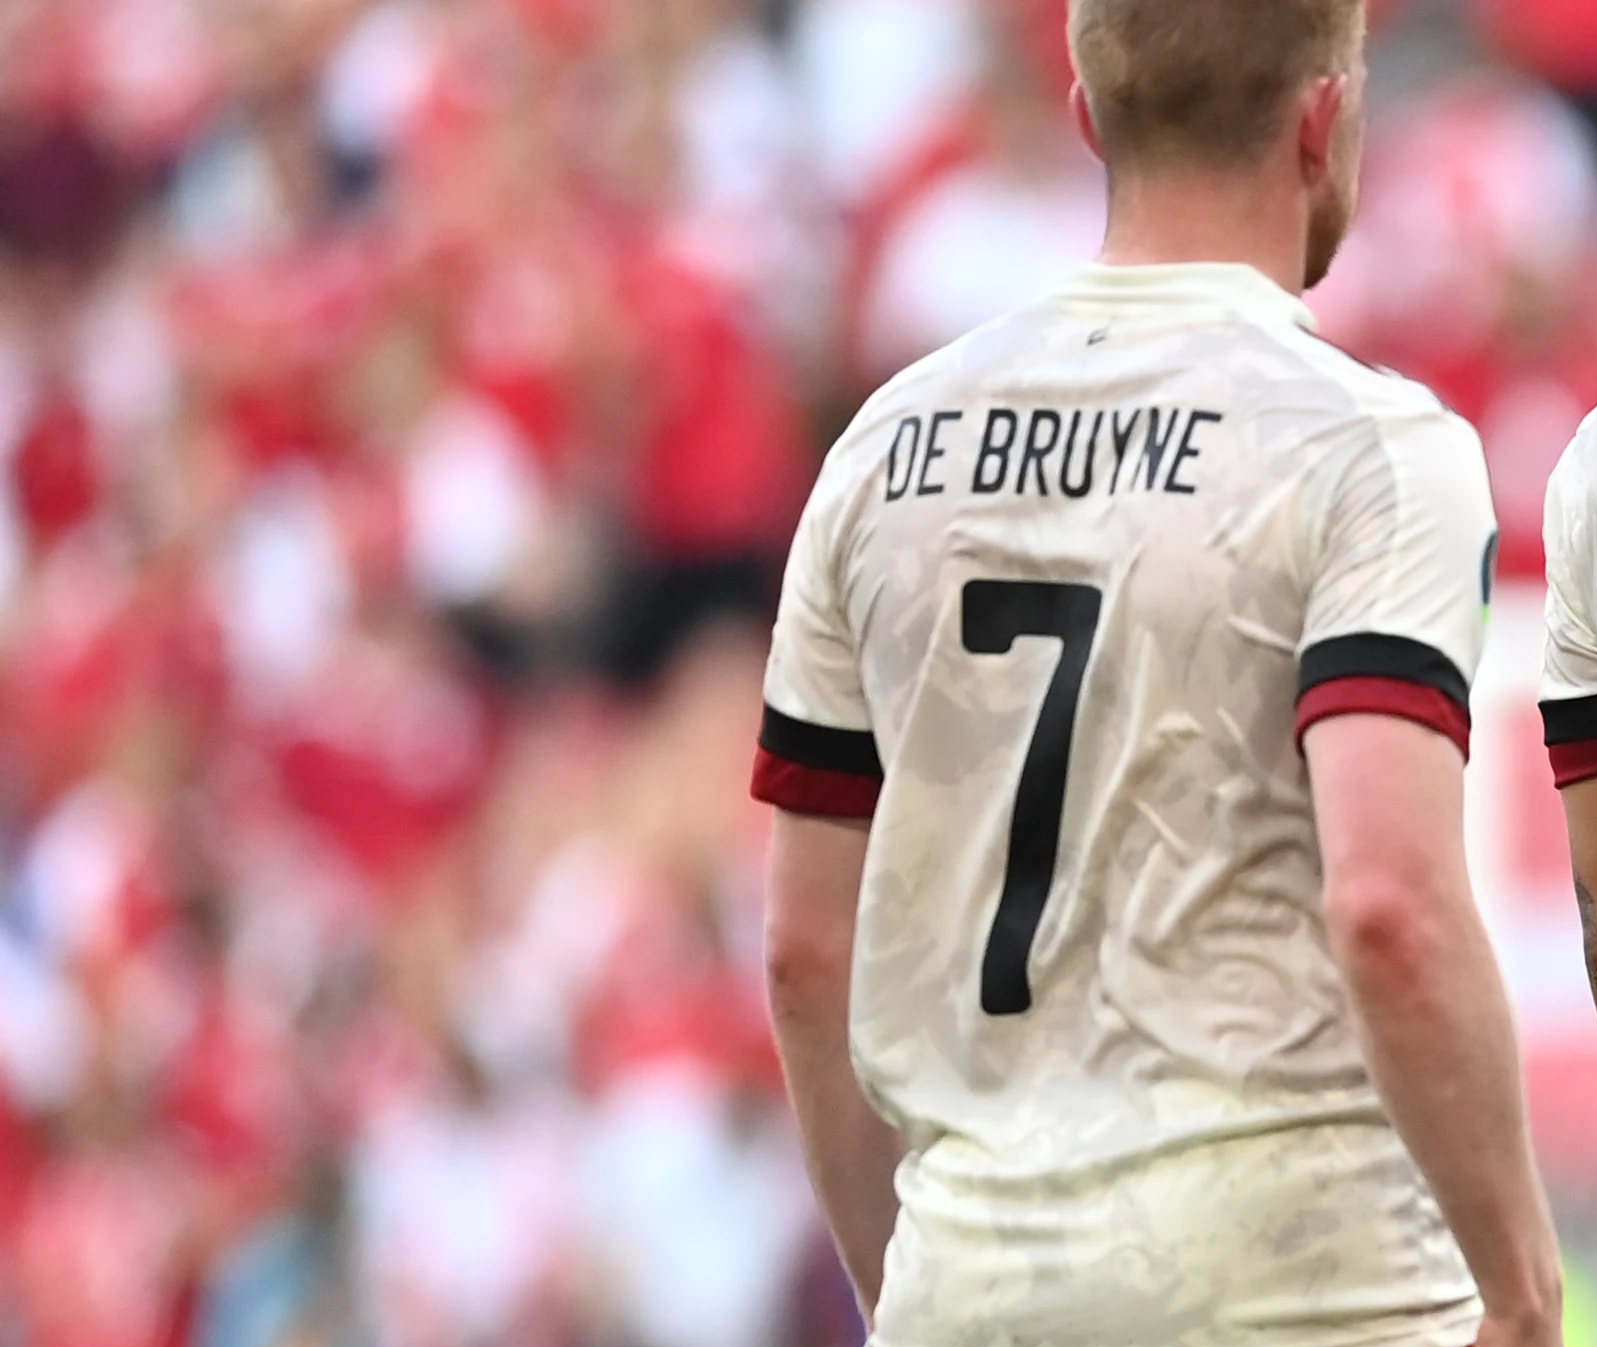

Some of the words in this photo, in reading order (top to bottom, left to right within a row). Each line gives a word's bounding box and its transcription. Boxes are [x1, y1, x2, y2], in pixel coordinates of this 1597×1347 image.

[885, 410, 963, 502] DE
[971, 406, 1223, 498] BRUYNE
[961, 578, 1103, 1017] 7
